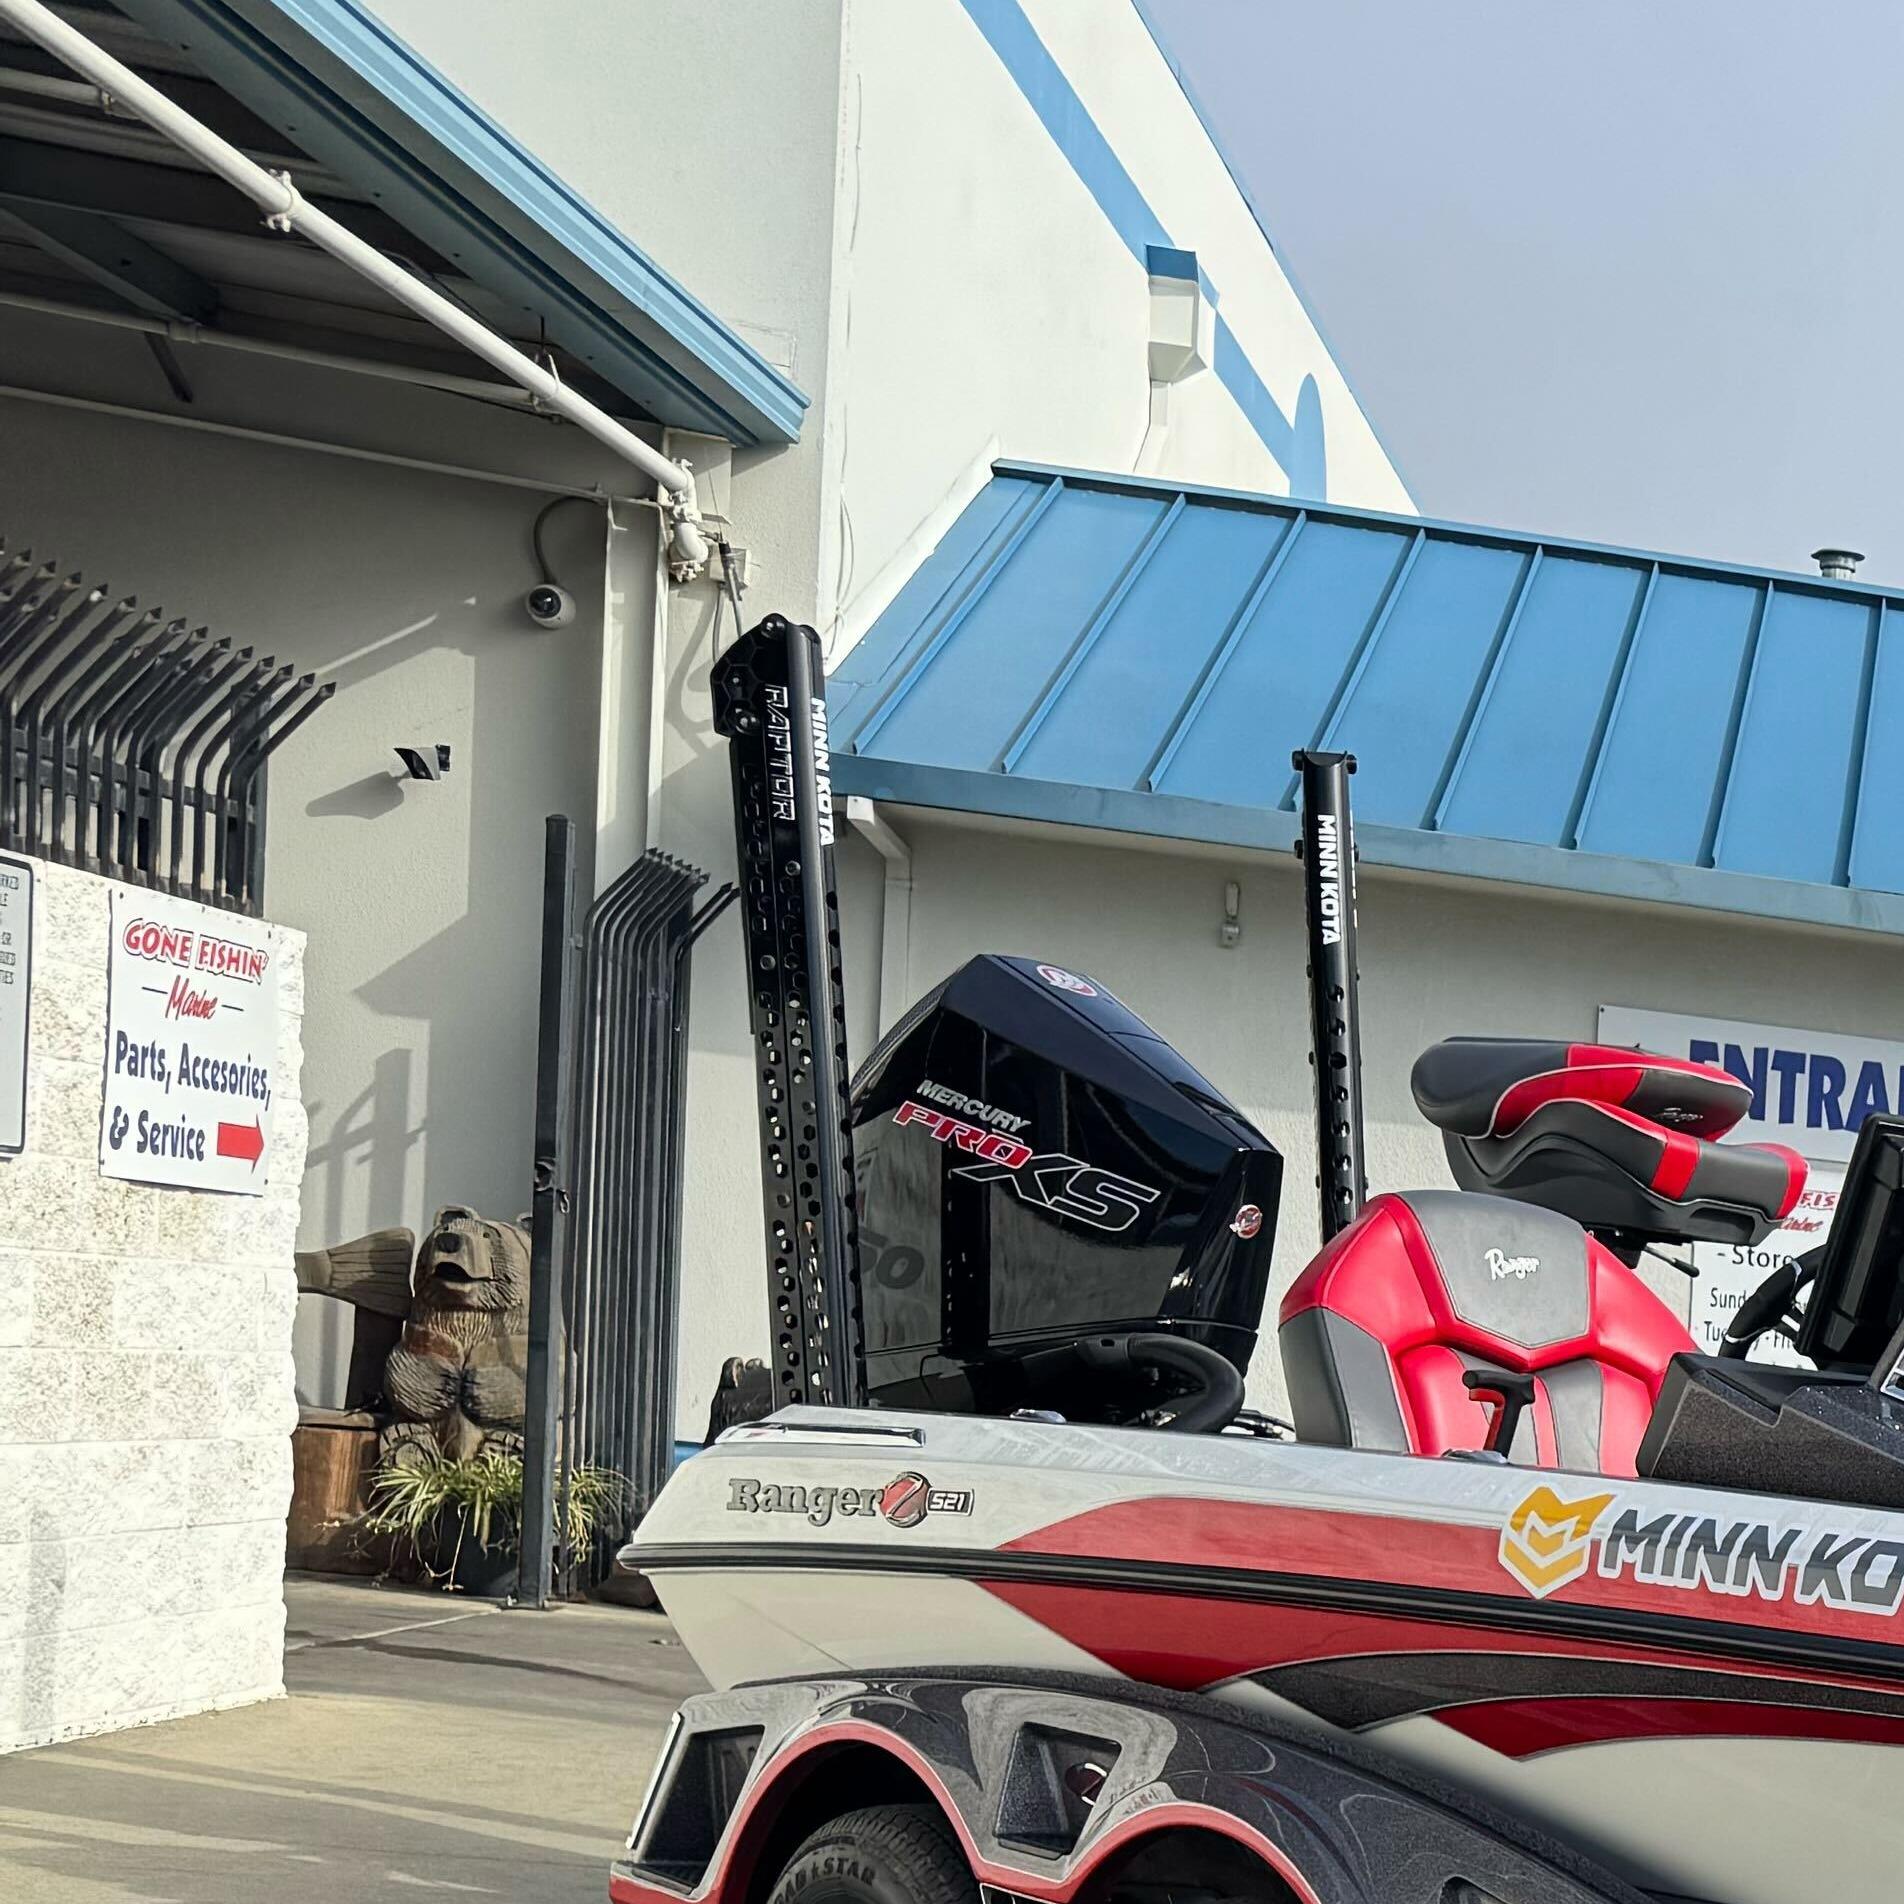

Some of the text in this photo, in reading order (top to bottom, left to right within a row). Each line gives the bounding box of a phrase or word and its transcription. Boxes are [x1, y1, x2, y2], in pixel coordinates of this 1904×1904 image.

[764, 683, 796, 821] RAPTOR
[811, 697, 835, 846] MINN KOTA
[1317, 814, 1341, 946] MINN KOTA
[124, 920, 269, 984] GONE FISHIN'
[115, 1029, 271, 1111] Parts, Accesories,
[916, 1080, 1031, 1132] MERCURY
[109, 1105, 206, 1161] & Service
[893, 1100, 1161, 1231] PRO XS
[1710, 1287, 1747, 1310] Sund
[727, 1478, 884, 1527] Ranger
[1603, 1508, 1802, 1592] MINN
